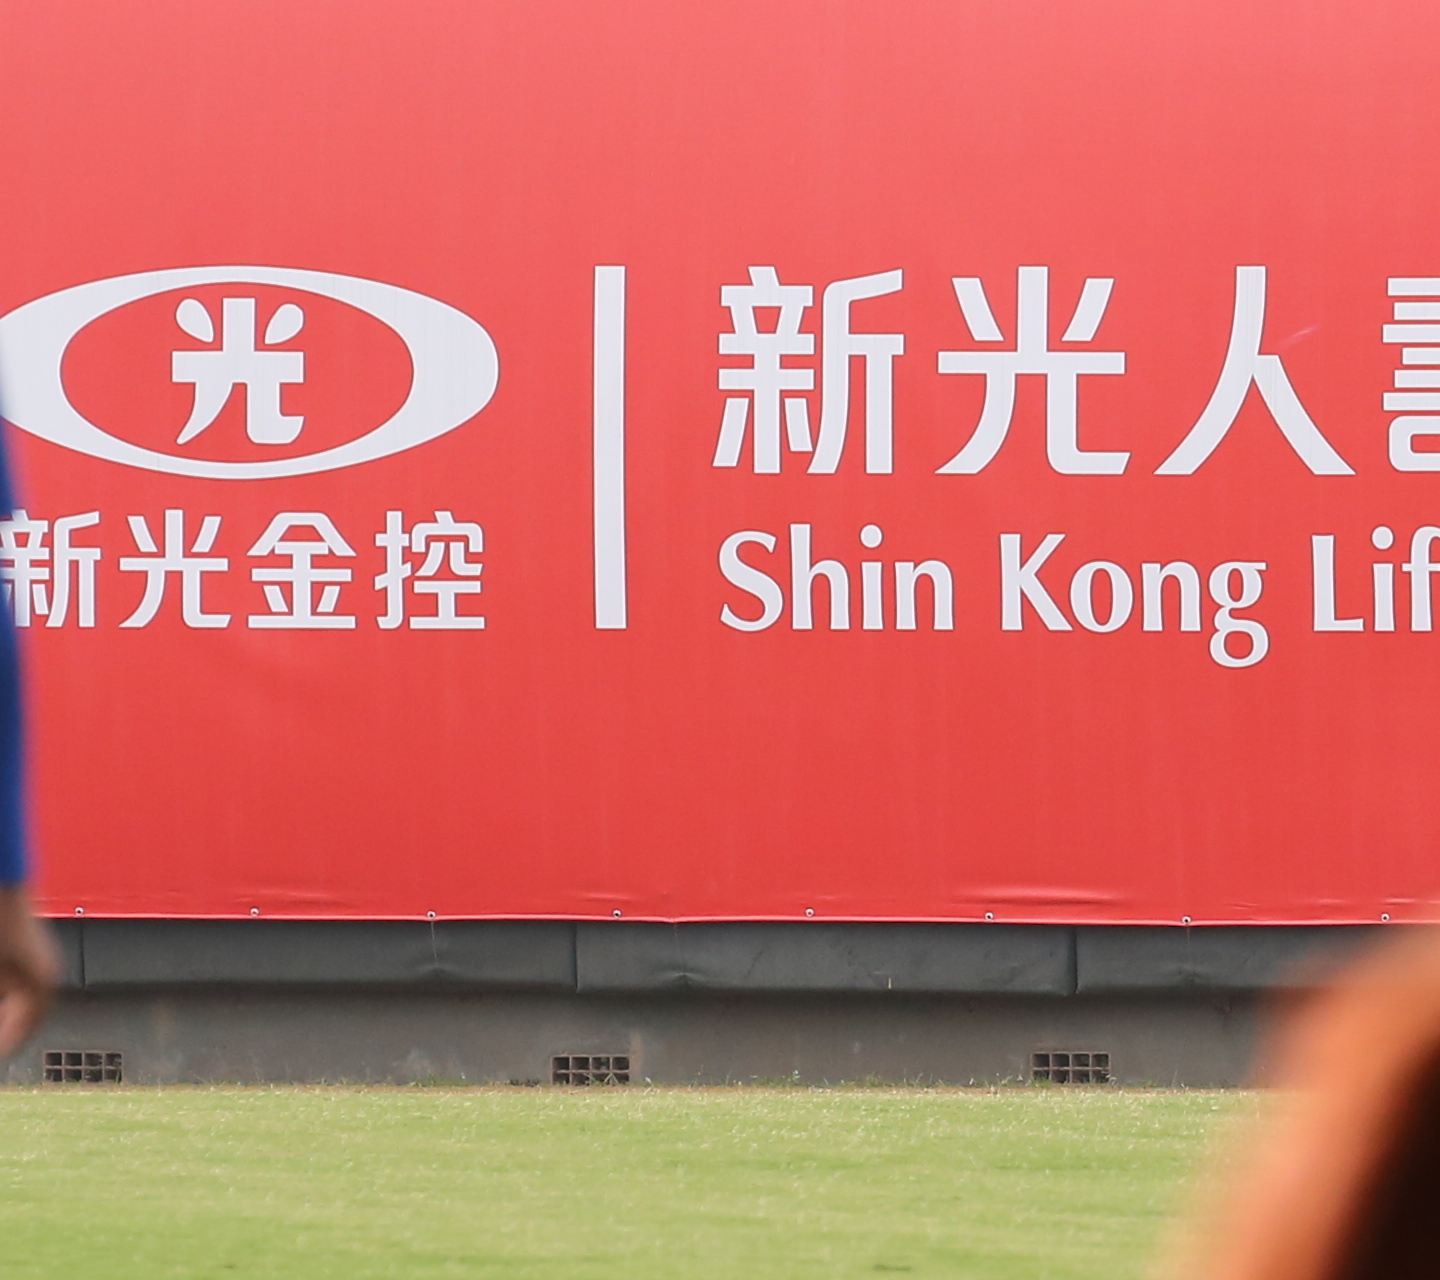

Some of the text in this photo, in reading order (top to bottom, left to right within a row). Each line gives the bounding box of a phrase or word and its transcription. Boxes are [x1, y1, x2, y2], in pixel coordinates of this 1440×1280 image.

[171, 296, 305, 445] 光
[718, 522, 956, 634] Shin
[998, 532, 1271, 669] Kong
